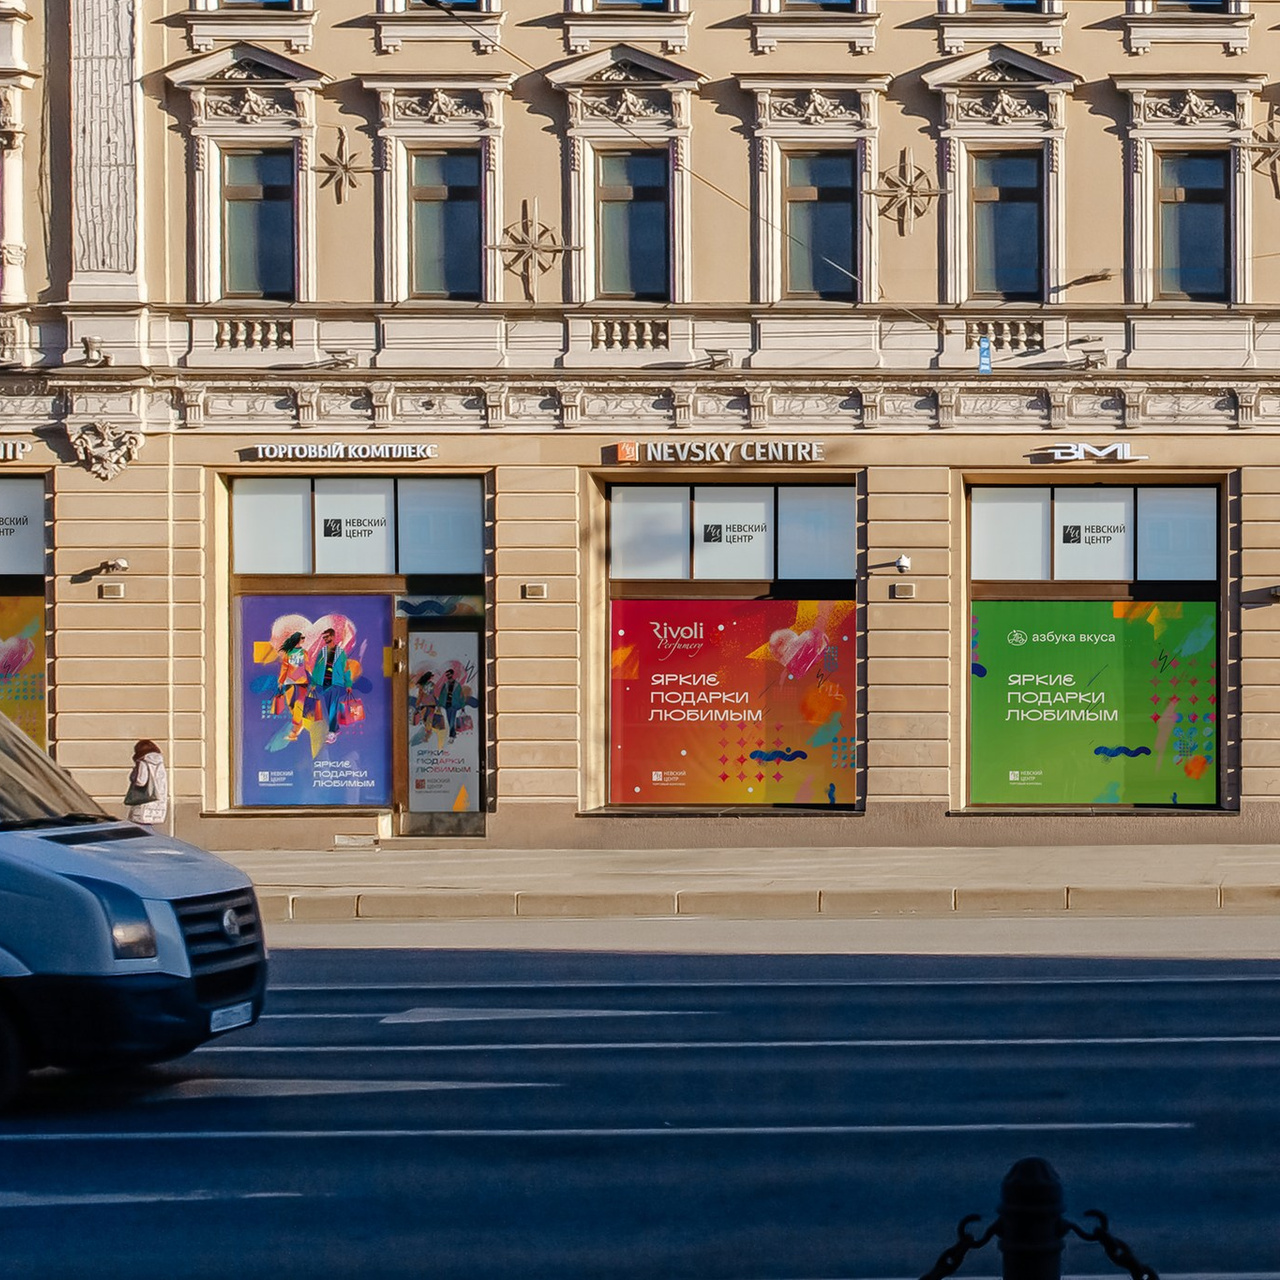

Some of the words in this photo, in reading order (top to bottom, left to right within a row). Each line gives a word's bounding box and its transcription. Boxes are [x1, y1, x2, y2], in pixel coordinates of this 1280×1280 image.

[0, 441, 33, 460] ТР
[254, 442, 345, 459] ТОРГОВЫЙ
[349, 444, 439, 459] КОМПЛЕКС
[647, 442, 735, 461] NEVSKY
[740, 442, 825, 461] CENTRE
[345, 517, 387, 527] НЕВСКИЙ
[725, 523, 767, 533] НЕВСКИЙ
[345, 529, 373, 539] ЦЕНТР
[1084, 524, 1126, 533] НЕВСКИЙ
[725, 535, 754, 544] ЦЕНТР
[1084, 535, 1112, 545] ЦЕНТР
[649, 621, 704, 639] Rivoli
[1032, 631, 1075, 645] азбука
[1079, 633, 1116, 645] вкуса
[657, 633, 704, 661] Perfumery
[650, 692, 749, 706] ПОДАРКИ
[1007, 691, 1105, 706] ПОДАРКИ
[648, 709, 763, 721] ЛЮБИМЫМ
[1005, 709, 1119, 722] ЛЮБИМЫМ
[313, 770, 368, 780] ПОДАРКИ
[312, 780, 375, 788] ЛЮБИМЫМ
